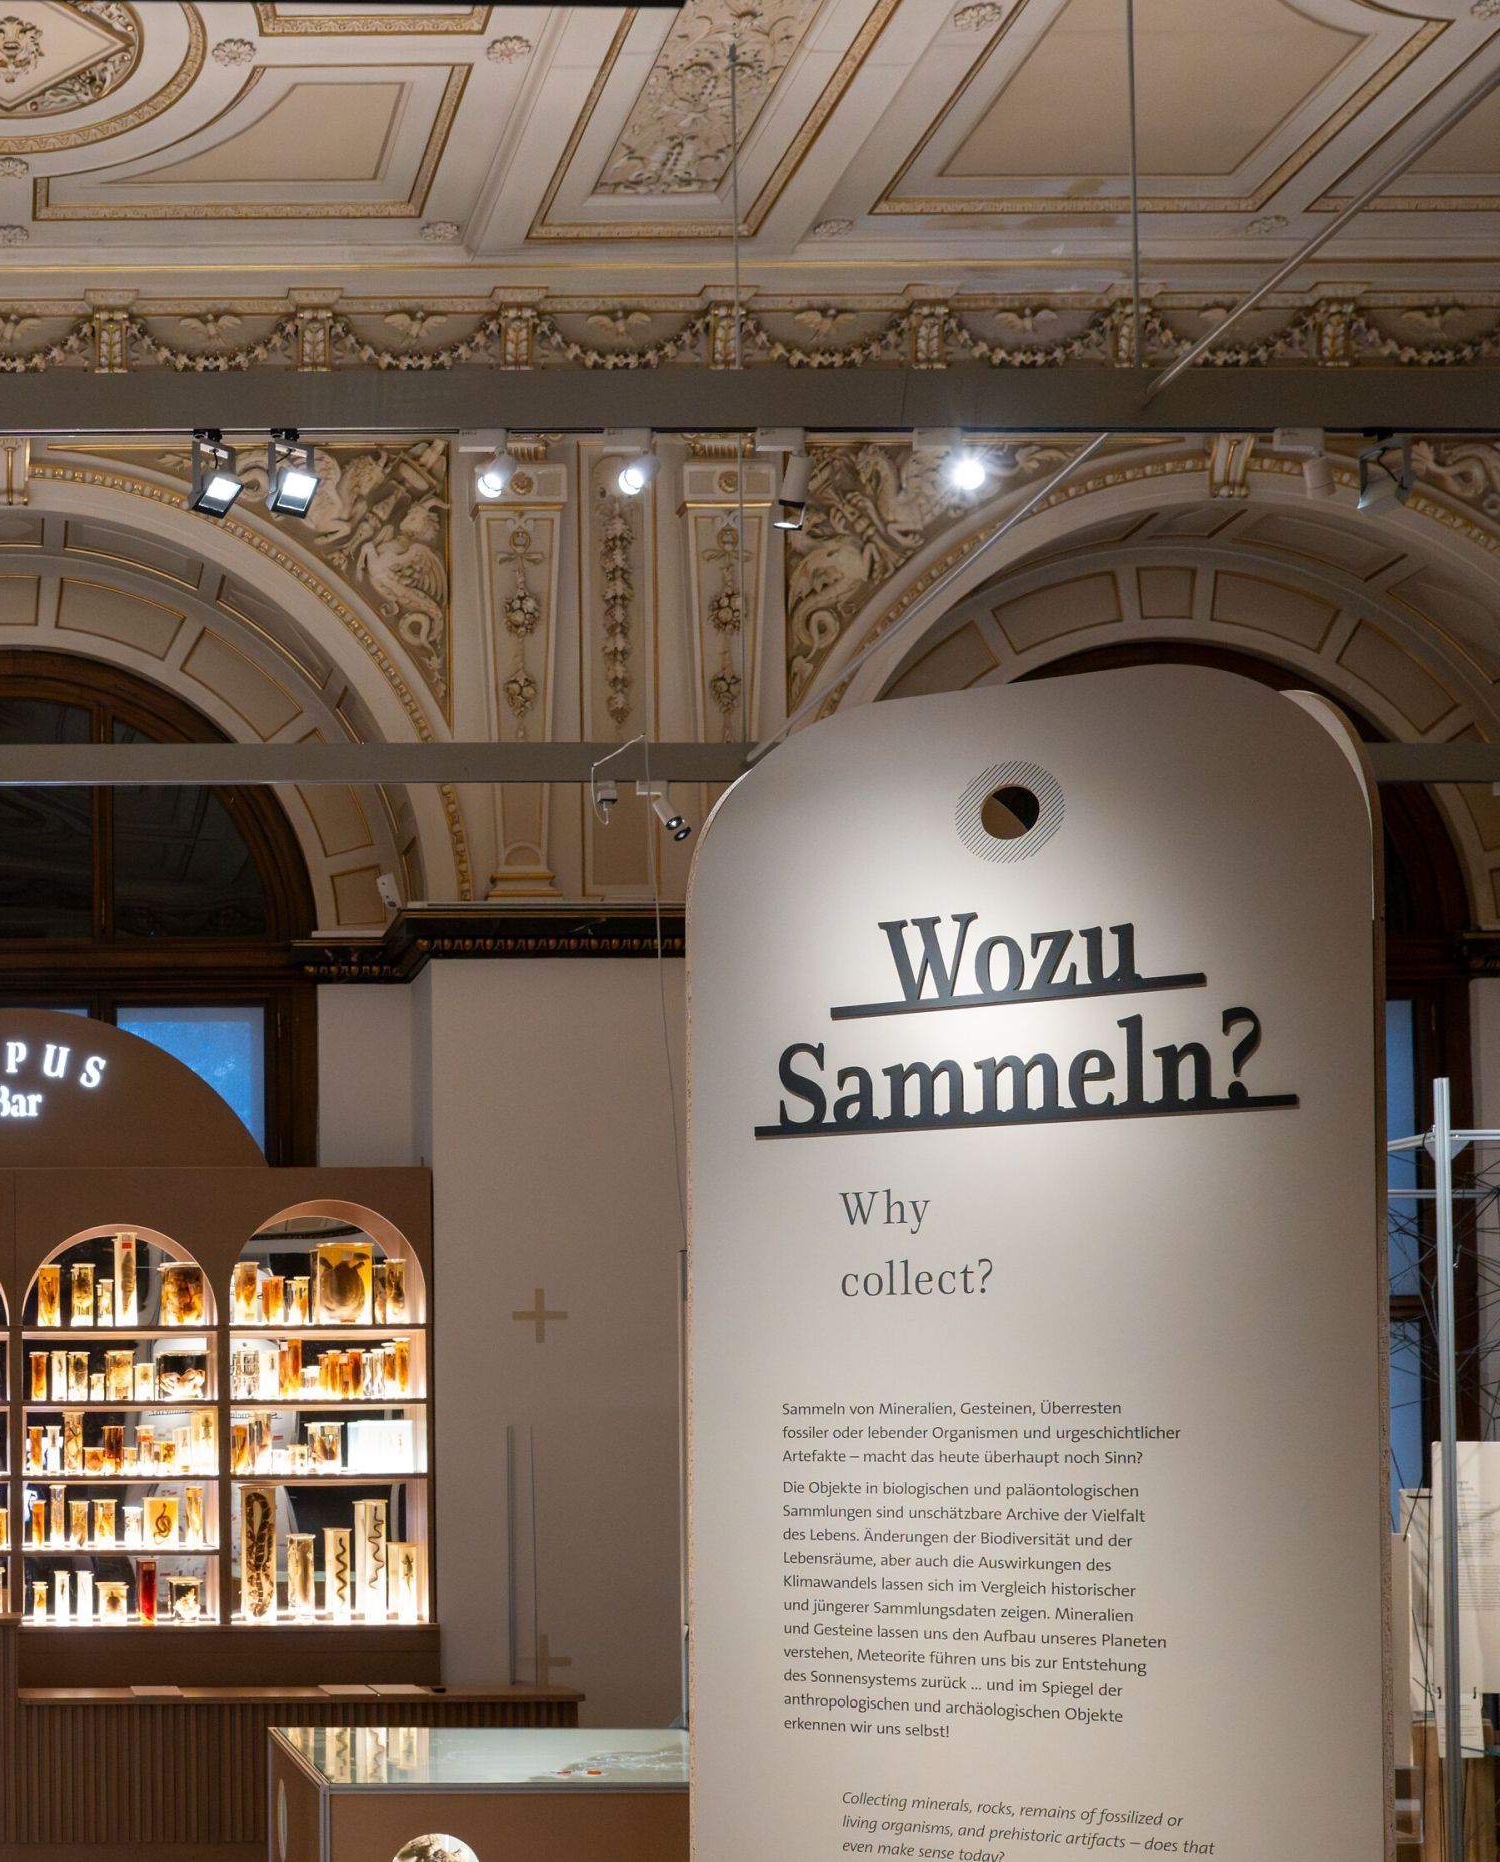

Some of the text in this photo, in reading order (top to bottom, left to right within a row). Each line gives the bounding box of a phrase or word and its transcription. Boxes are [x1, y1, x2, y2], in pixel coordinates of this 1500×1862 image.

[878, 912, 1144, 1001] Wozu
[778, 1007, 1262, 1126] Sammeln?
[839, 1189, 931, 1235] Why
[841, 1258, 994, 1298] collect?
[782, 1399, 1122, 1417] Sammeln von Mineralien, Gesteinen, Überresten
[782, 1425, 1181, 1443] fossiler oder lebender Organismen und urgeschichtlicher
[782, 1449, 847, 1463] Artefakte
[863, 1449, 907, 1463] macht
[910, 1449, 935, 1463] das
[939, 1450, 980, 1464] heute
[984, 1450, 1060, 1468] überhaupt
[1064, 1450, 1100, 1464] noch
[1104, 1450, 1143, 1464] Sinn?
[783, 1481, 1139, 1501] Die Objekte in biologischen und paläontologischen
[783, 1504, 1146, 1523] Sammlungen sind unschätzbare Archive der Vielfalt
[783, 1527, 1133, 1547] des Lebens. Änderungen der Biodiversität und der
[783, 1551, 1112, 1575] Lebensräume, aber auch die Auswirkungen des
[783, 1574, 1136, 1598] Klimawandels lassen sich im Vergleich historischer
[783, 1597, 1134, 1623] und jüngerer Sammlungsdaten zeigen. Mineralien
[784, 1621, 1167, 1649] und Gesteine lassen uns den Aufbau unseres Planeten
[783, 1646, 1147, 1677] verstehen, Meteorite führen uns bis zur Entstehung
[783, 1667, 807, 1682] des
[810, 1670, 917, 1689] Sonnensystems
[921, 1675, 967, 1690] zurück
[986, 1678, 1014, 1692] und
[1018, 1679, 1038, 1693] im
[1041, 1680, 1094, 1699] Spiegel
[1098, 1682, 1123, 1697] der
[784, 1692, 1123, 1725] anthropologischen und archäologischen Objekte
[784, 1716, 949, 1738] erkennen wir uns selbst!
[842, 1791, 1184, 1827] Collecting minerals, rocks, remains of fossilized or
[842, 1814, 878, 1834] living
[881, 1820, 954, 1838] organisms,
[957, 1824, 986, 1838] and
[988, 1827, 1063, 1844] prehistoric
[1065, 1832, 1126, 1850] artifacts
[1144, 1836, 1179, 1852] does
[1183, 1840, 1216, 1855] that
[842, 1842, 1005, 1862] even make sense today?
